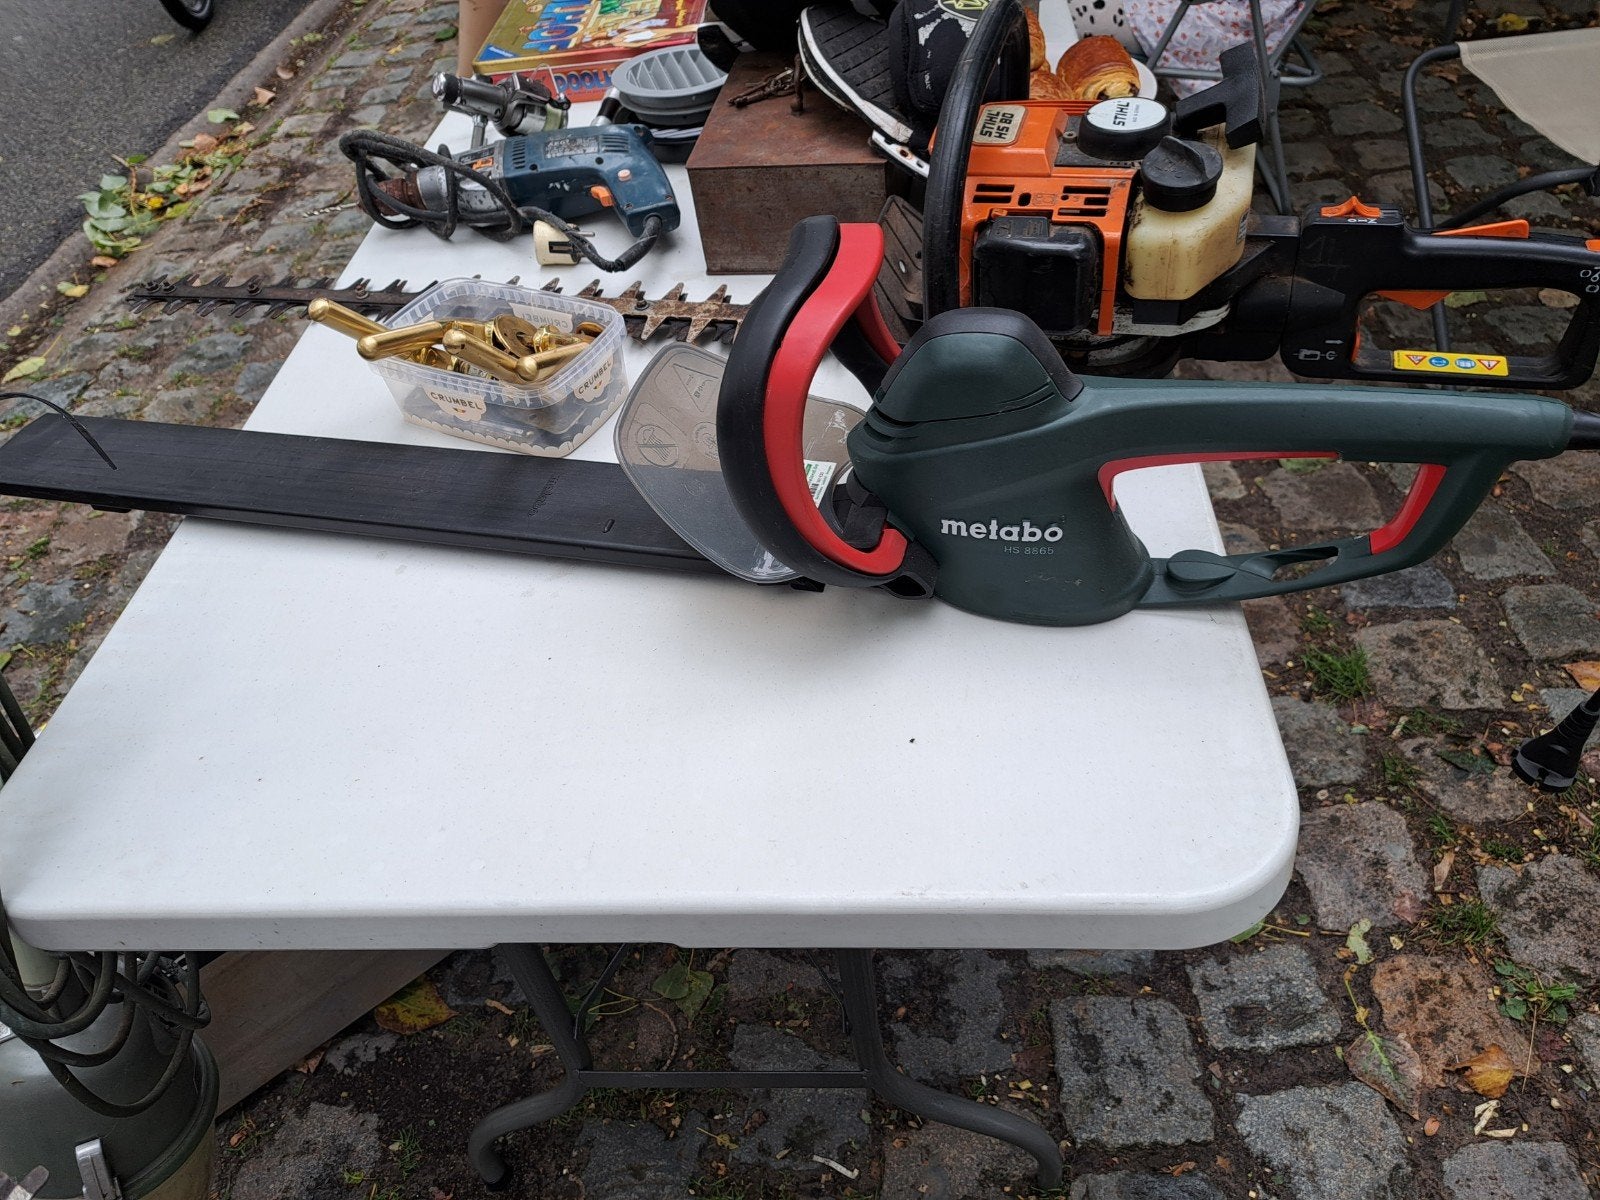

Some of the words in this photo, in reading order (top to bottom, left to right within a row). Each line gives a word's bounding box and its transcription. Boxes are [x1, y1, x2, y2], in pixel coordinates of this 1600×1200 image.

[980, 110, 1000, 138] STIHL
[999, 112, 1015, 125] 80
[1113, 102, 1130, 126] STIHL
[994, 125, 1010, 140] HS
[578, 360, 612, 395] CRUMBEL
[430, 391, 483, 411] CRUMBEL
[940, 519, 1063, 542] metabo
[1004, 545, 1020, 554] HS
[1024, 546, 1054, 555] 8865
